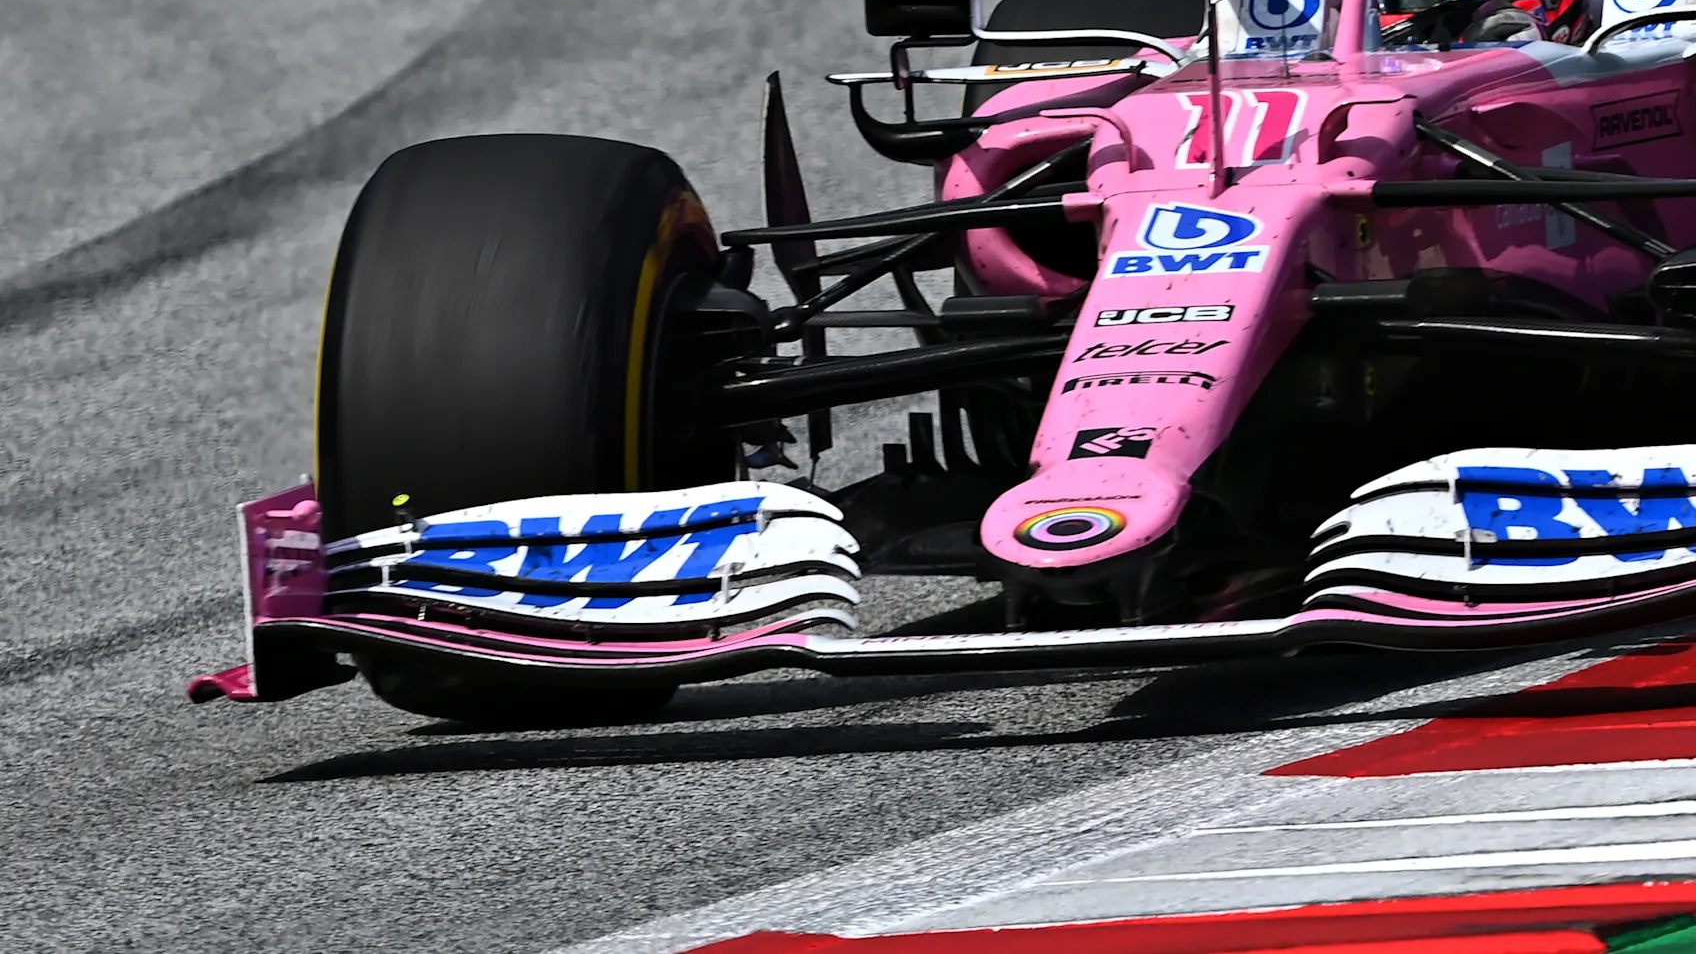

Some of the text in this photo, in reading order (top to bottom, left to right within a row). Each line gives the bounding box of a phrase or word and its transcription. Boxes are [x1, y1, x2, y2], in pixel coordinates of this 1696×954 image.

[1175, 87, 1309, 169] 11
[1111, 251, 1260, 275] BWT
[1097, 305, 1233, 326] JCB
[1060, 371, 1218, 395] PIRELLI
[392, 496, 768, 609] BWT
